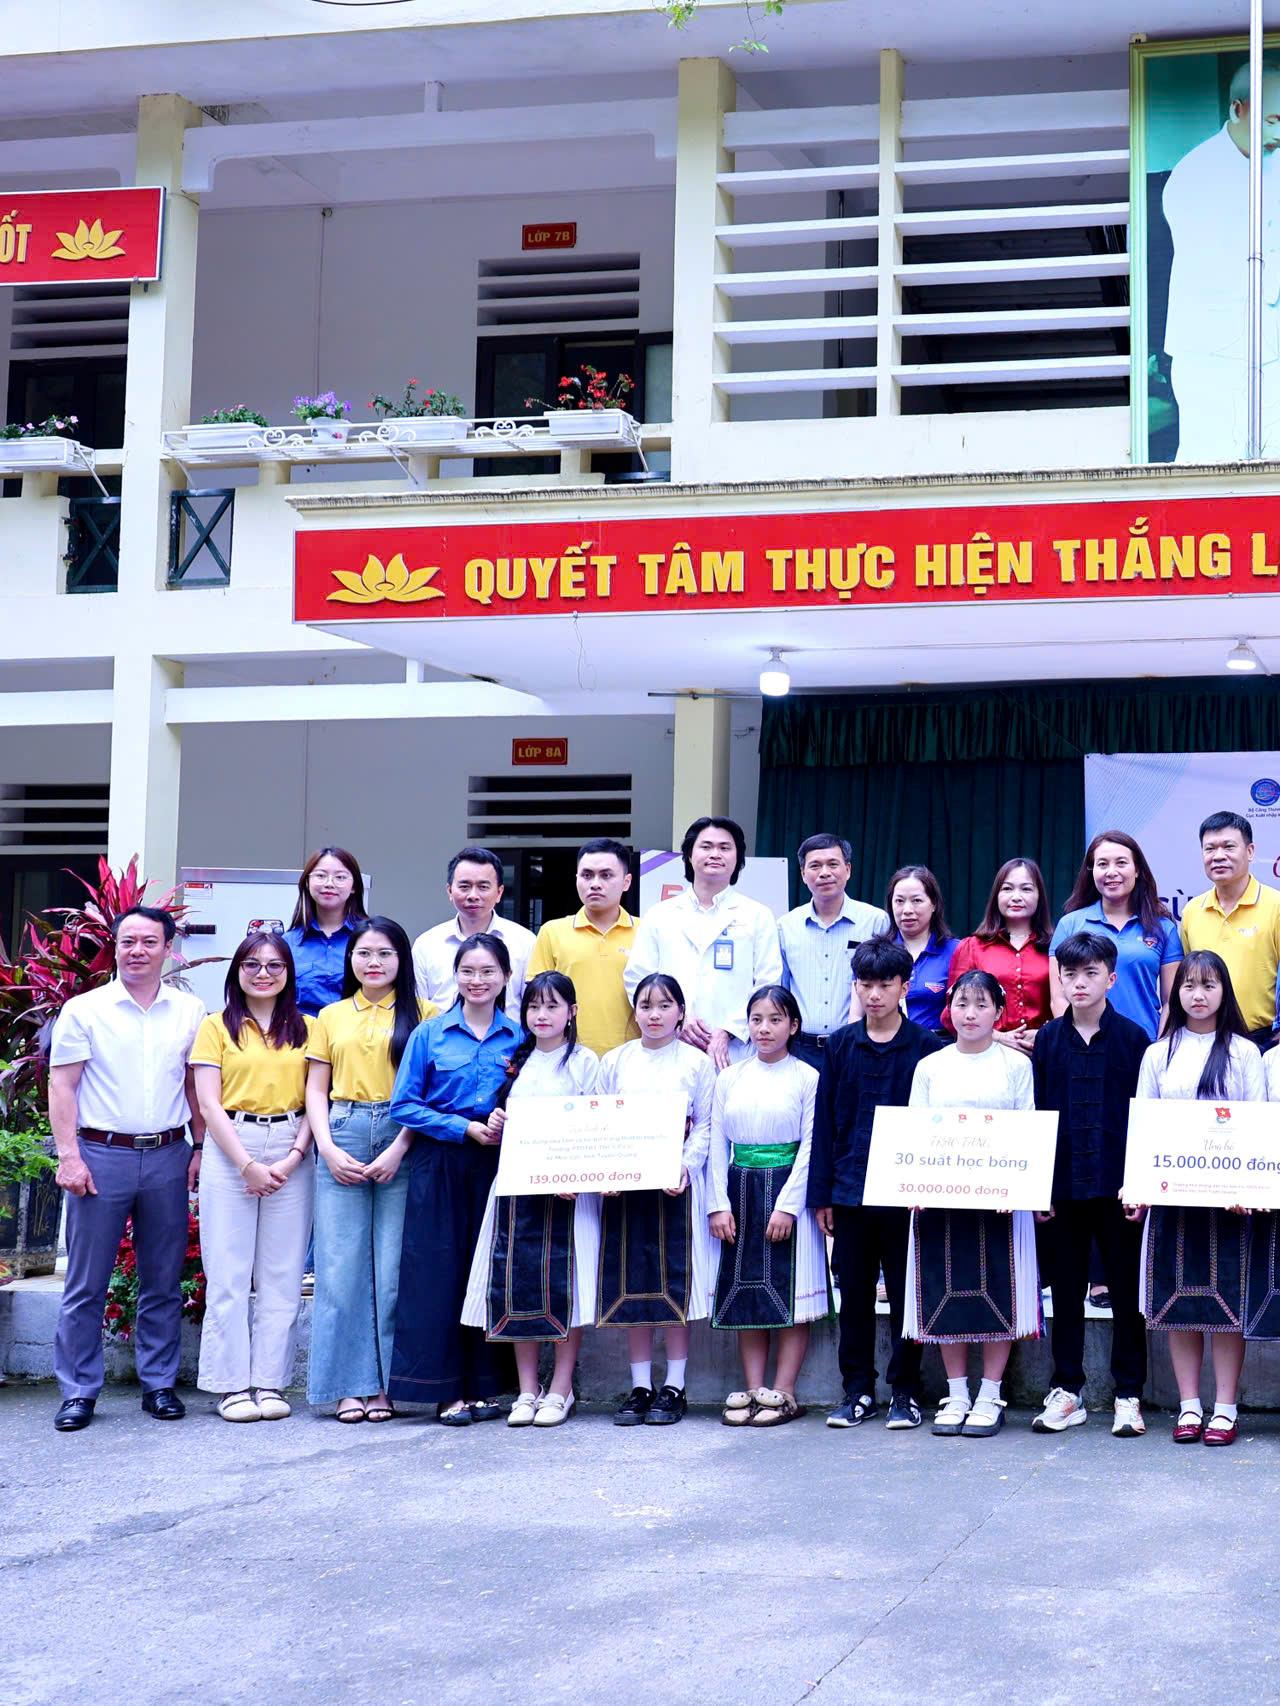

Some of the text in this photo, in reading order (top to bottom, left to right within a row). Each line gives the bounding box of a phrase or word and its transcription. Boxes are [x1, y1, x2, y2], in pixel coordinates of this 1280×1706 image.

[527, 229, 570, 243] LỚP 7B
[463, 541, 618, 605] QUYẾT
[638, 541, 744, 595] TÂM
[765, 542, 896, 600] THỰC
[914, 531, 1034, 595] HIỆN
[1052, 516, 1232, 583] THẮNG
[518, 744, 562, 758] LỚP 8A
[894, 1152, 915, 1166] 30
[956, 1155, 984, 1171] học
[1152, 1154, 1243, 1170] 15.000.000
[529, 1172, 605, 1184] 139.000.000
[897, 1183, 972, 1195] 30.000.000
